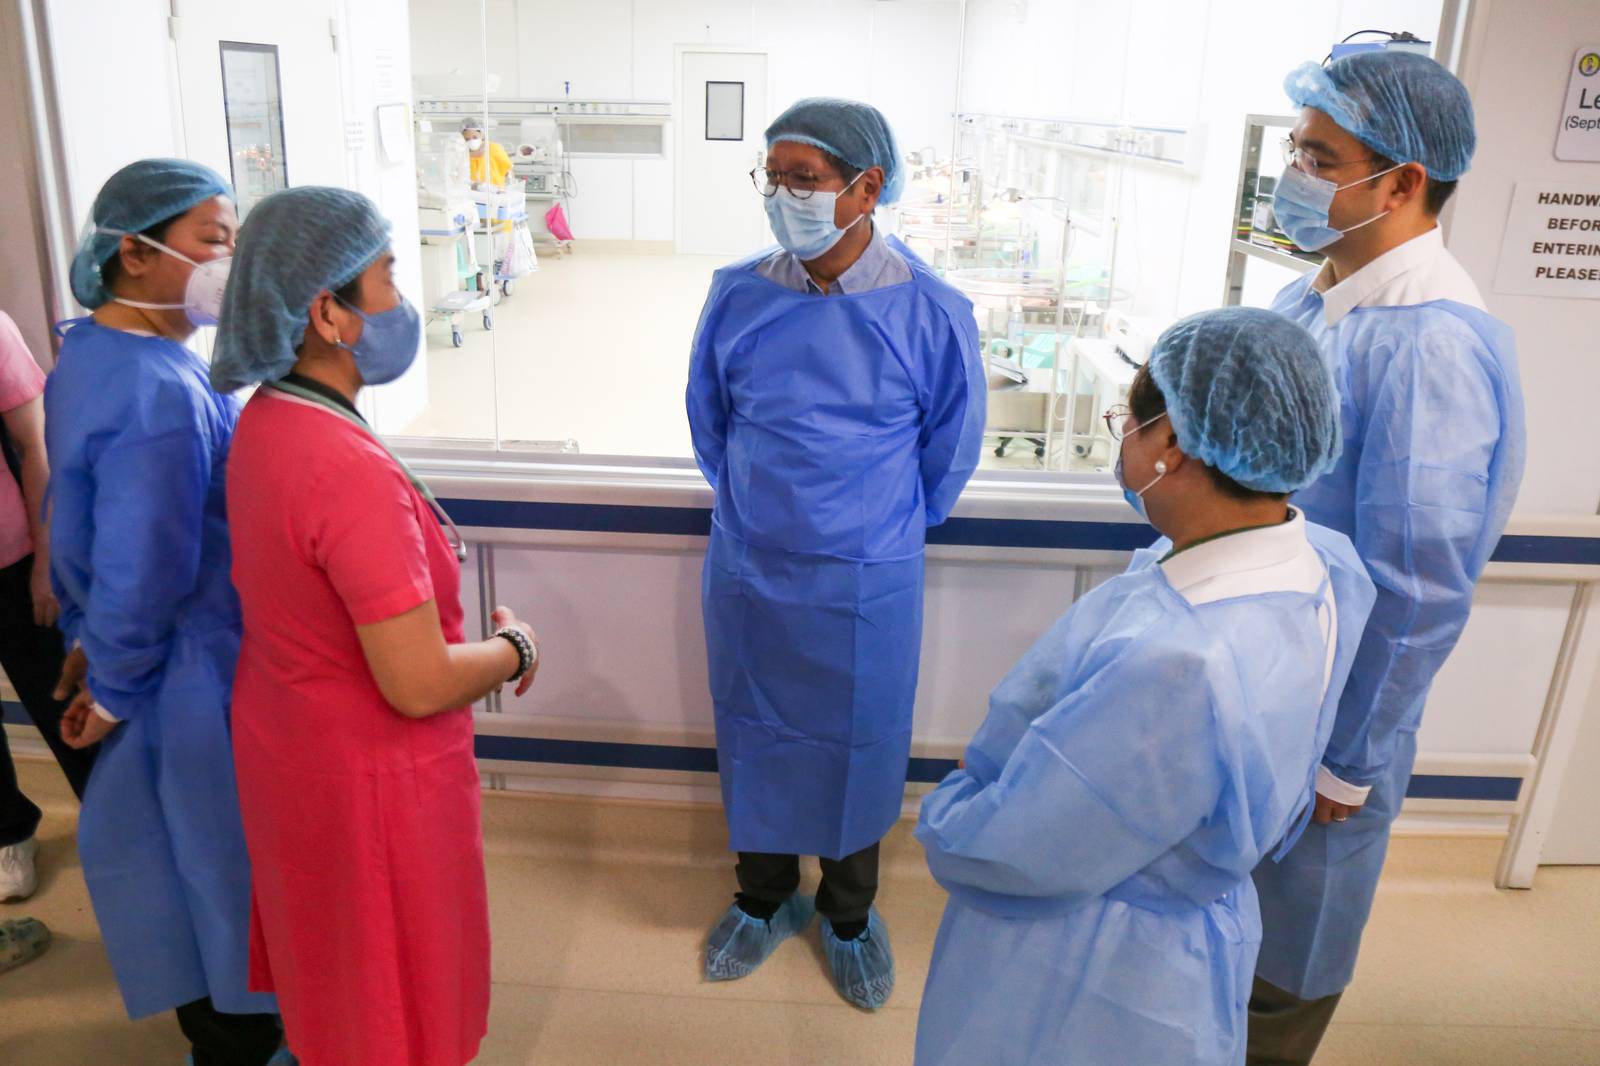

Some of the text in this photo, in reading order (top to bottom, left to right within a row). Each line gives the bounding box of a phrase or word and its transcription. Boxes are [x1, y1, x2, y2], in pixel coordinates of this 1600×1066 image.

[1538, 193, 1600, 207] HANDW
[1547, 218, 1600, 231] BEFOR
[1535, 267, 1600, 281] PLEASE
